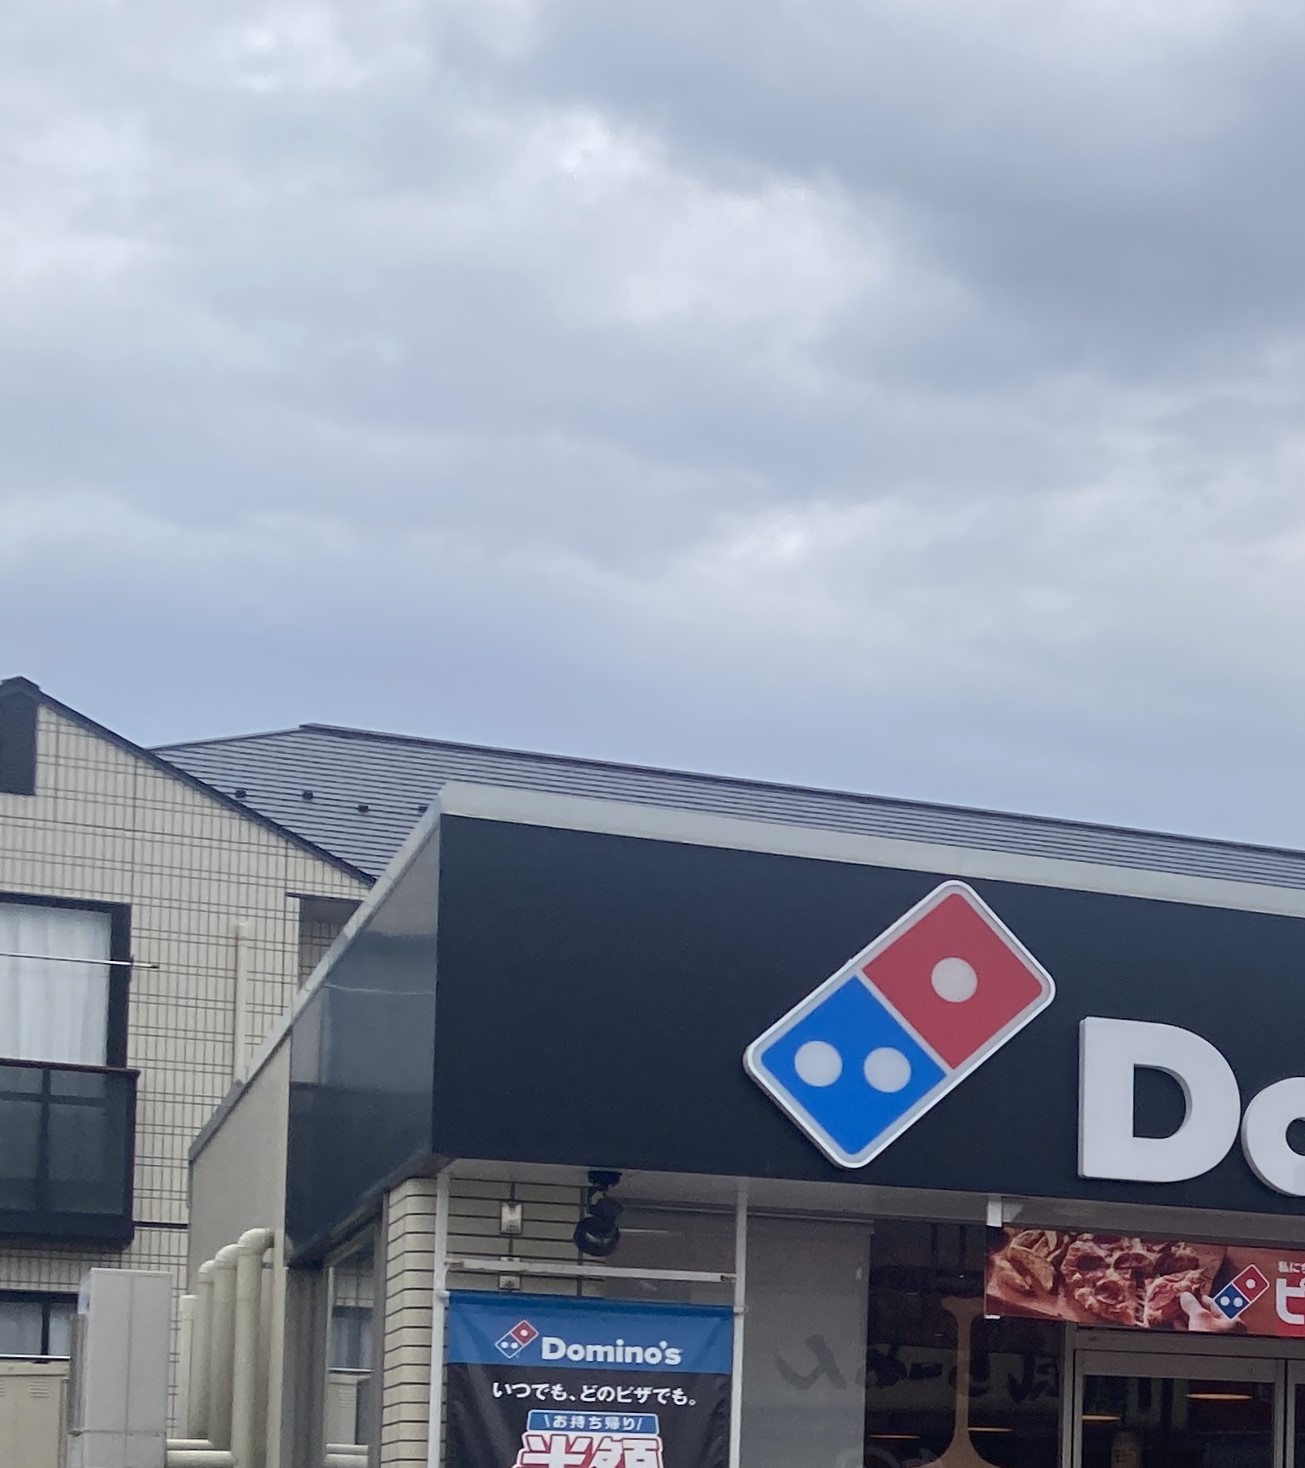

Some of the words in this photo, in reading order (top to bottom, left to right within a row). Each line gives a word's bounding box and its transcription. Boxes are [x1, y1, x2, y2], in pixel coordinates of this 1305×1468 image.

[541, 1336, 683, 1366] Domino's
[492, 1381, 697, 1407] いつでも、どのピザでも。
